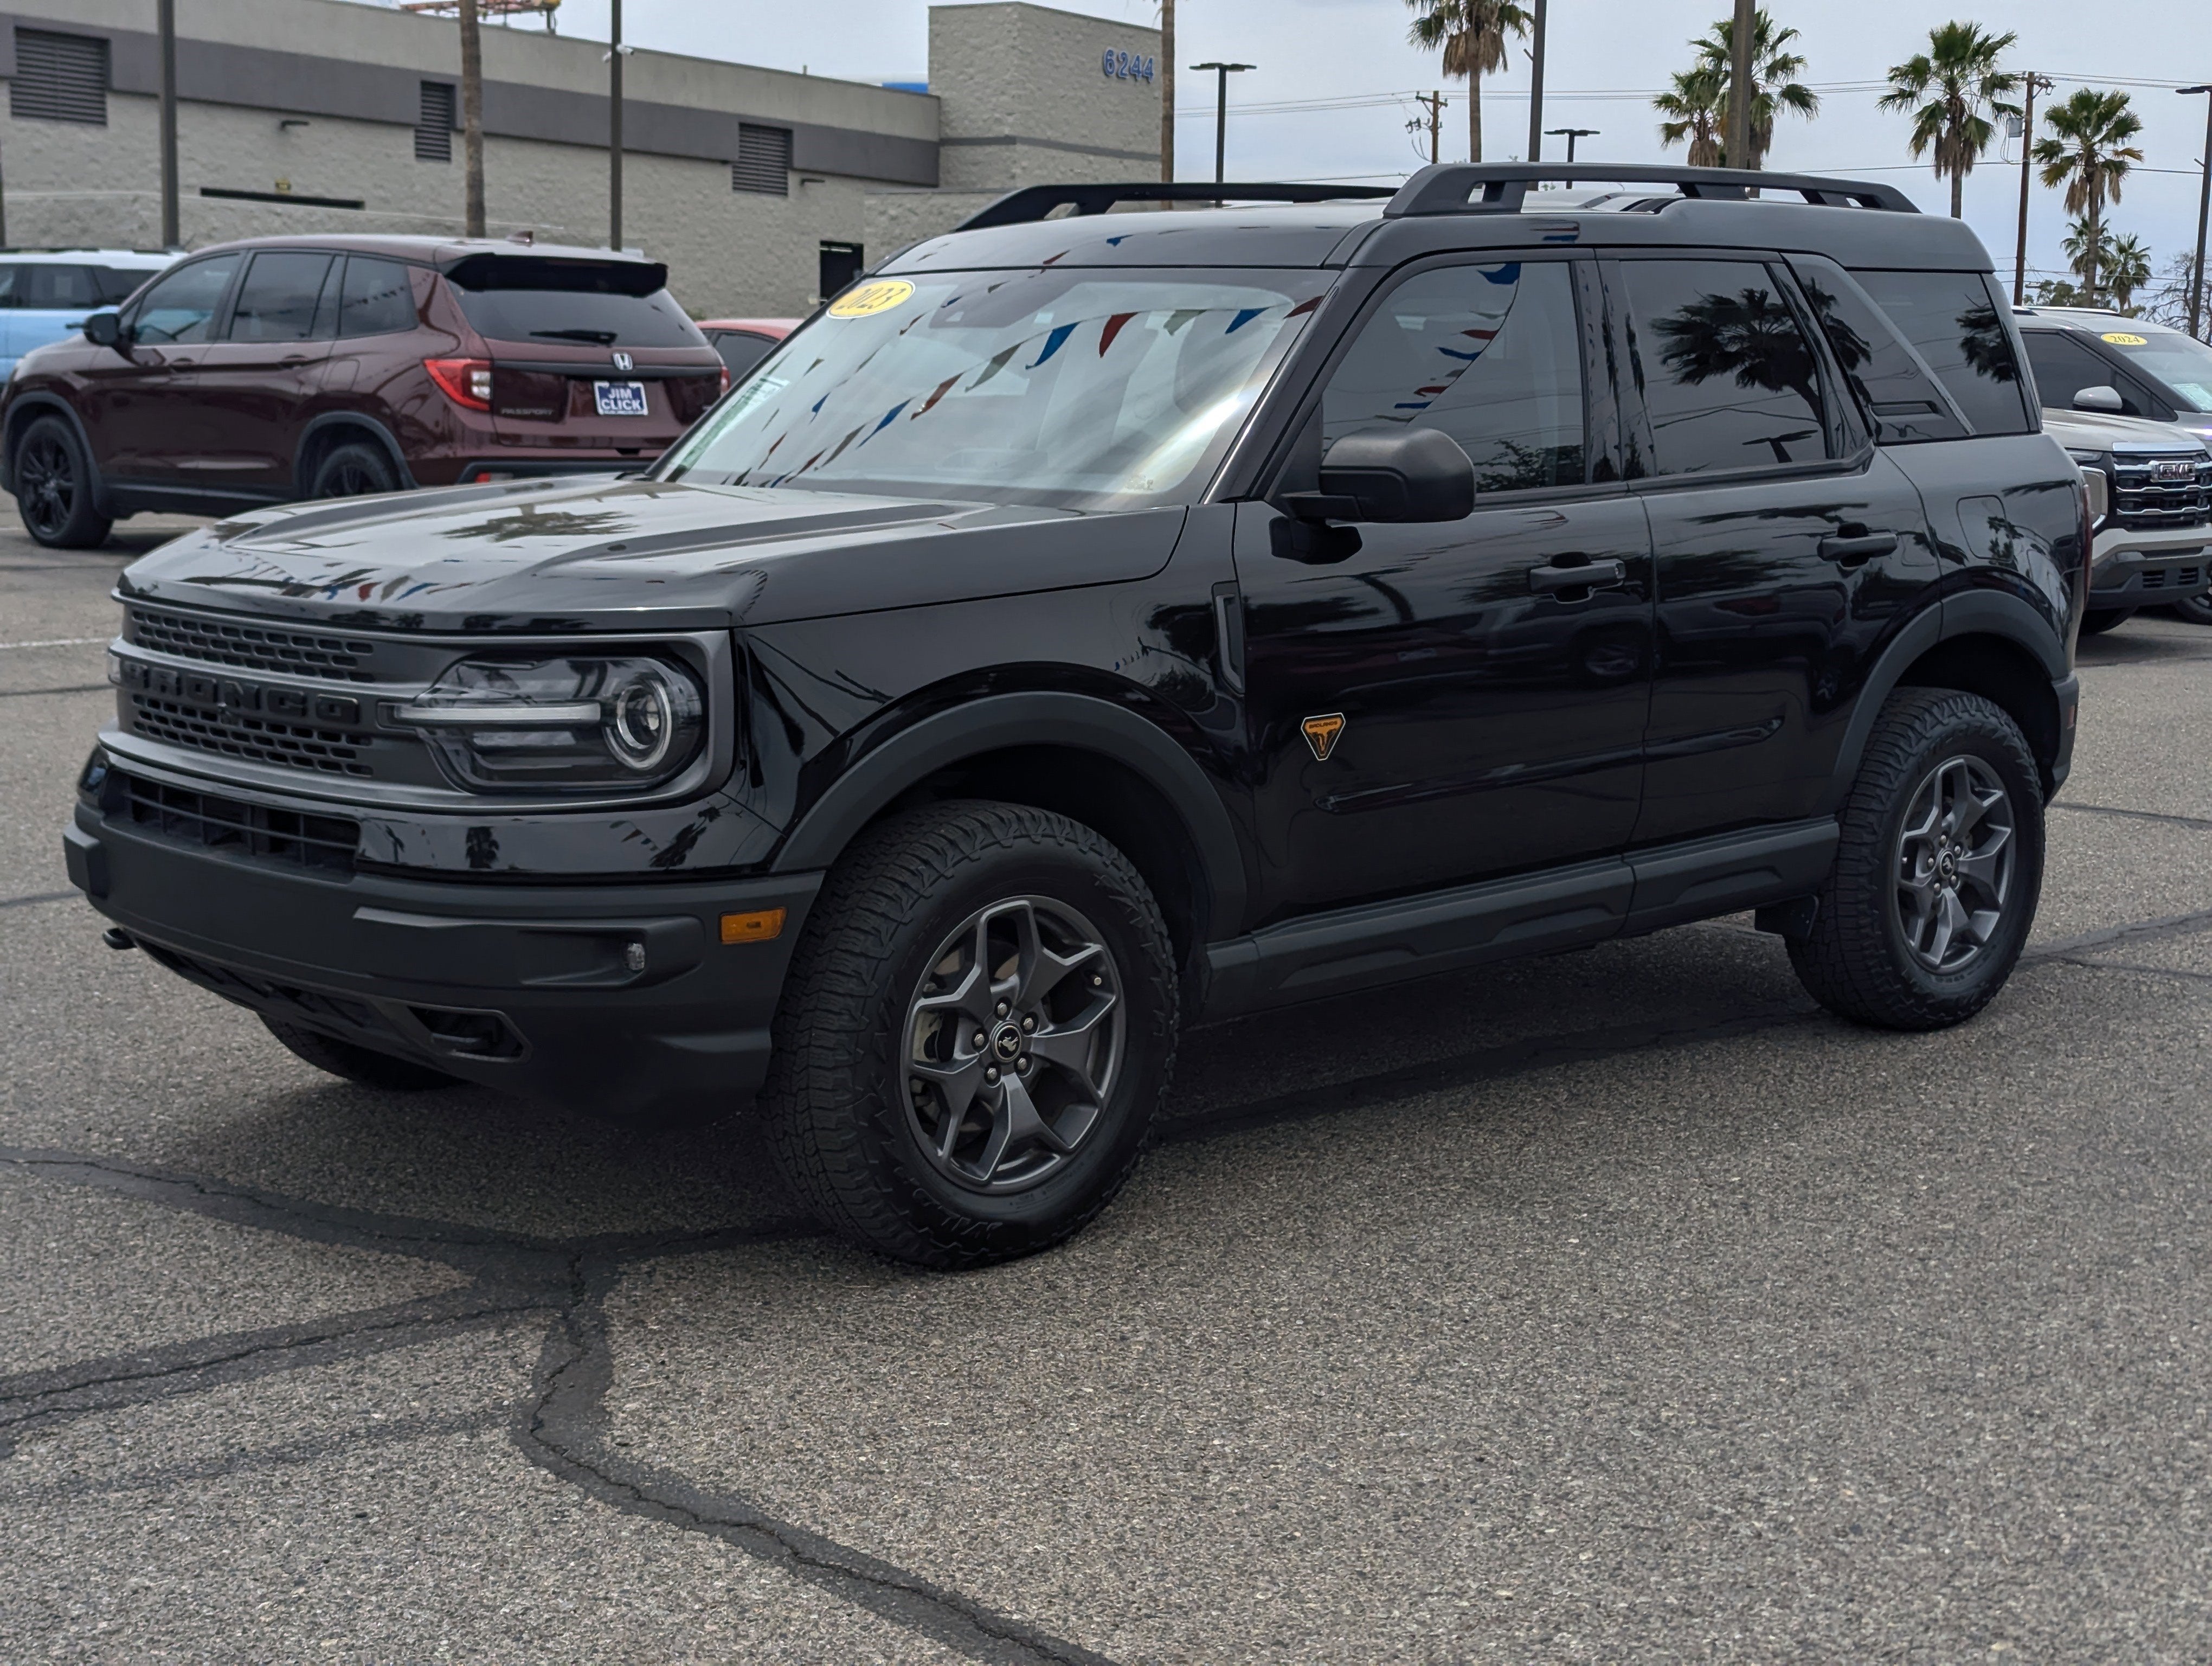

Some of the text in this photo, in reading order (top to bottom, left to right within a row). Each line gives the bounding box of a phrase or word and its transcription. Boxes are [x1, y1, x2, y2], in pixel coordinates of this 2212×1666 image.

[1104, 49, 1154, 82] 6244
[836, 287, 907, 310] 2023
[2110, 335, 2140, 343] 2024
[608, 388, 632, 399] JIM
[501, 408, 554, 416] PASSPORT
[601, 399, 641, 411] CLICK
[2158, 463, 2196, 480] GMC
[123, 663, 361, 725] BRONCO
